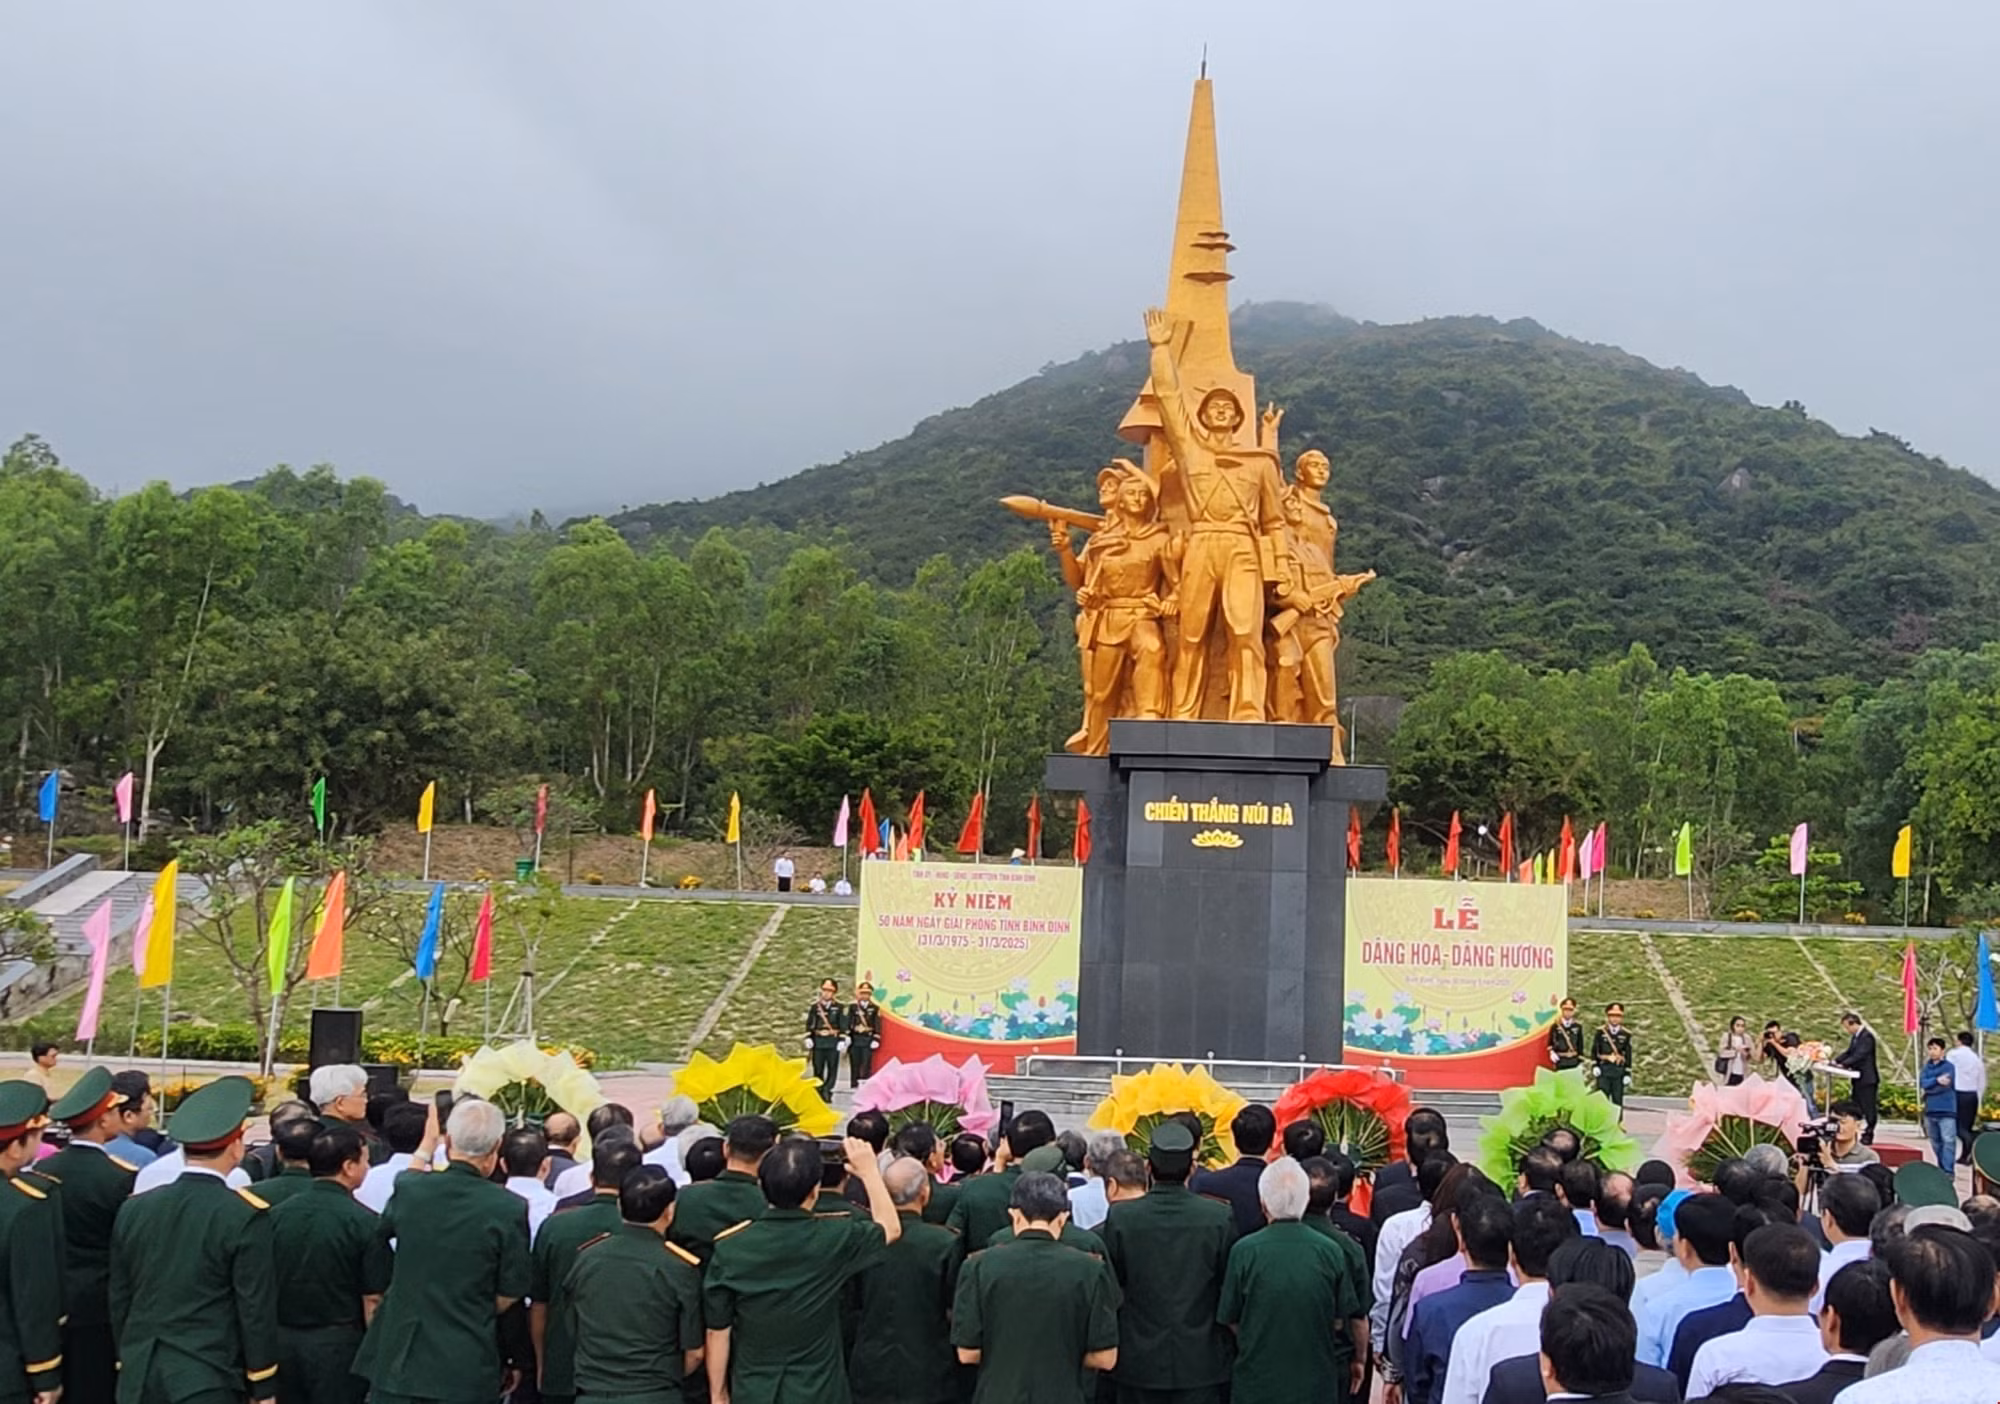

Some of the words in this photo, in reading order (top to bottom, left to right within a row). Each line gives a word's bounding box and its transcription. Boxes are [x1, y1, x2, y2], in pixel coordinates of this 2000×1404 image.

[1145, 795, 1188, 821] CHIẾN
[1191, 796, 1239, 823] THẮNG
[1242, 802, 1268, 824] NÚI
[1272, 802, 1293, 825] BÀ
[934, 886, 957, 908] KỶ
[966, 890, 1012, 912] NIỆM
[878, 915, 890, 927] 50
[1433, 897, 1479, 930] LỄ
[918, 933, 969, 948] (31/3/1975
[978, 935, 1029, 950] 31/3/2025)
[1362, 937, 1405, 965] DÂNG
[1411, 942, 1441, 966] HOA
[1452, 940, 1494, 968] DÂNG
[1500, 944, 1553, 969] HƯƠNG
